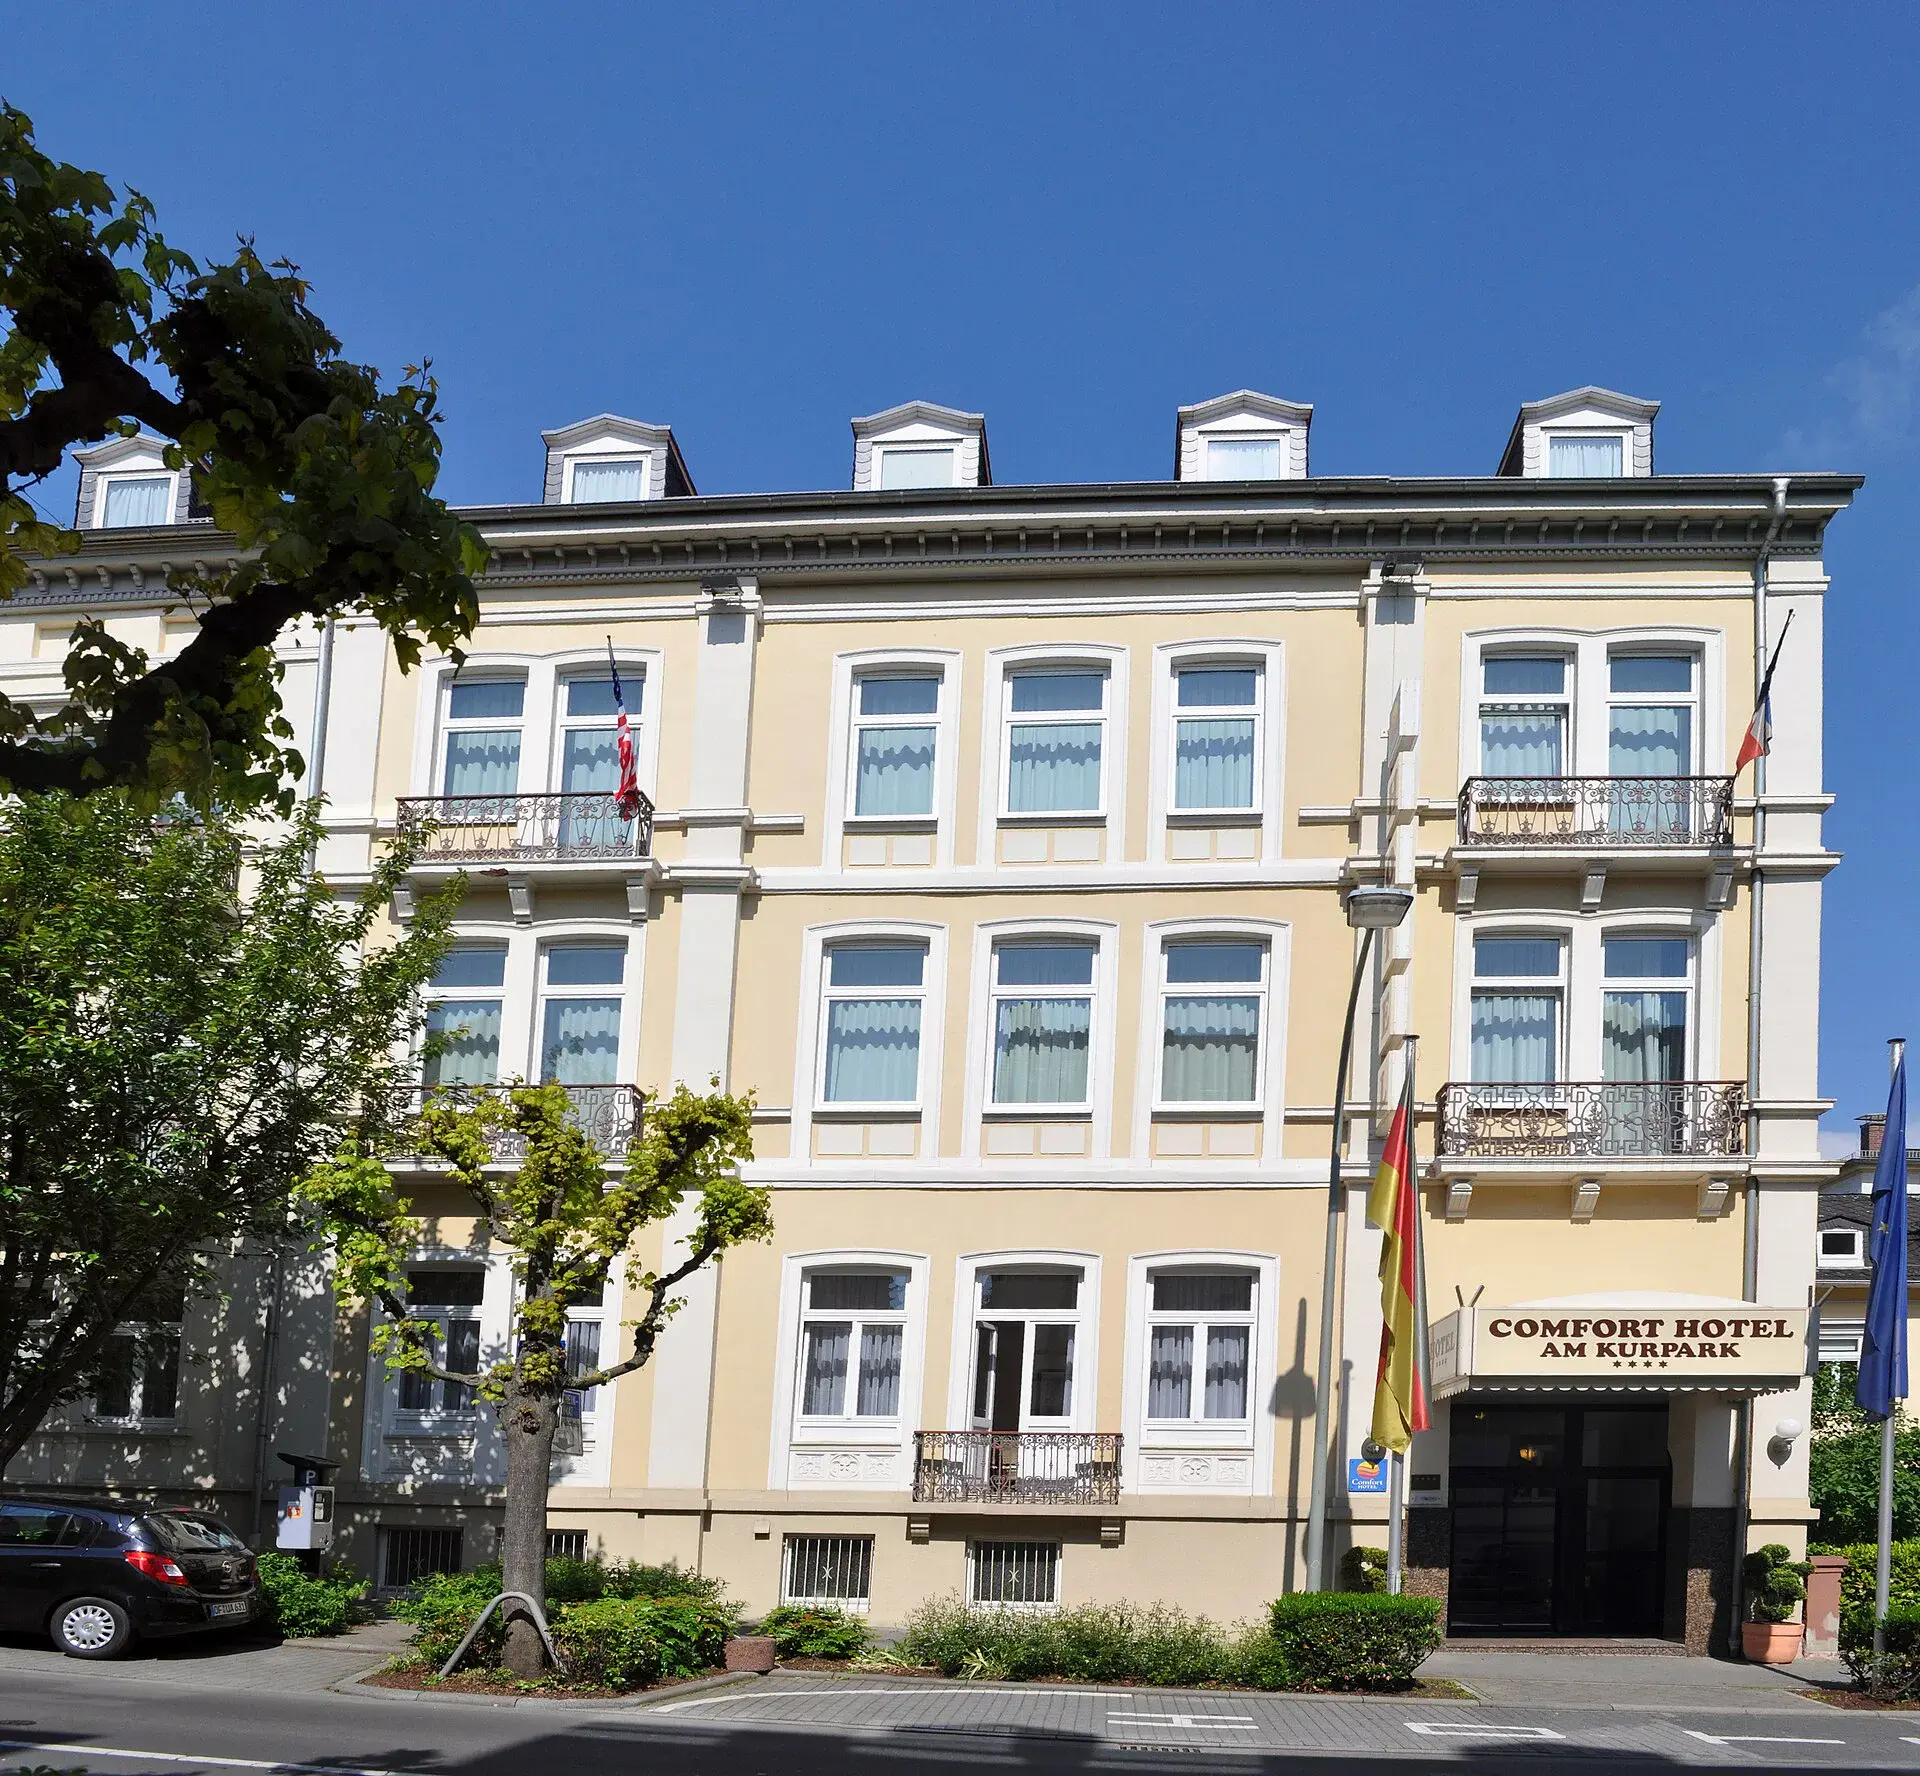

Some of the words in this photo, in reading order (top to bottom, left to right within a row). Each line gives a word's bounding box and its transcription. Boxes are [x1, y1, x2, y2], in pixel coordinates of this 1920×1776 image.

[1489, 1319, 1665, 1338] COMFORT
[1674, 1319, 1794, 1338] HOTEL
[1540, 1342, 1587, 1358] AM
[1596, 1342, 1741, 1358] KURPARK
[306, 1470, 316, 1484] P
[1351, 1478, 1383, 1486] Comfort
